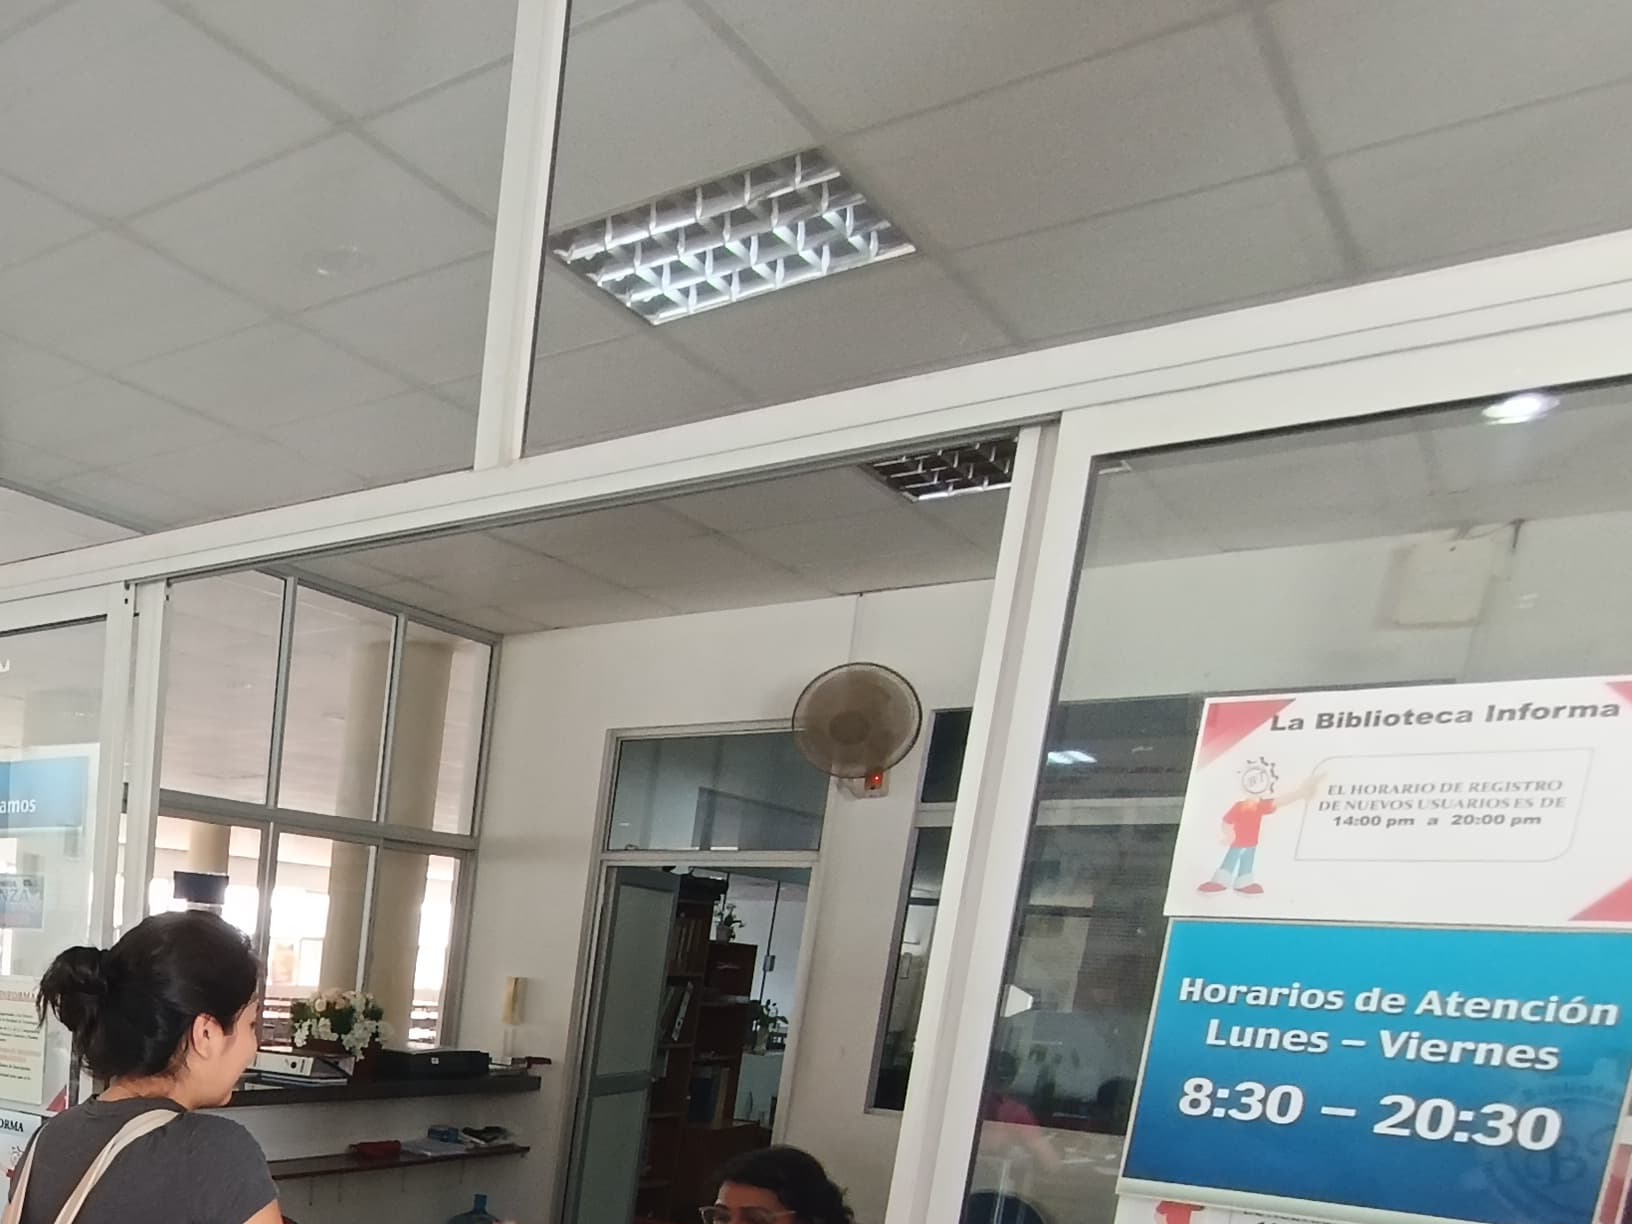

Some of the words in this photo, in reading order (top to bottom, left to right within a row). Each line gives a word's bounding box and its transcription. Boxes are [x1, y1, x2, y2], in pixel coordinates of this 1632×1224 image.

[1270, 713, 1304, 732] La
[1314, 705, 1474, 730] Biblioteca
[1484, 700, 1621, 723] Informa
[1318, 800, 1340, 812] DE
[1344, 799, 1414, 812] NUEVOS
[1417, 798, 1511, 810] USUARIOS
[1513, 797, 1534, 809] ES
[1539, 796, 1568, 809] DE
[1327, 784, 1347, 796] EL
[1350, 782, 1436, 796] HORARIO
[1439, 782, 1465, 794] DE
[1468, 780, 1563, 793] REGISTRO
[1333, 815, 1382, 827] 14:00
[1386, 817, 1416, 829] pm
[1426, 817, 1439, 826] a
[1451, 814, 1506, 826] 20:00
[1510, 816, 1542, 828] pm
[1178, 977, 1344, 1011] Horarios
[1354, 987, 1406, 1015] de
[1416, 990, 1620, 1027] Atención
[1205, 1019, 1330, 1053] Lunes
[1379, 1030, 1560, 1071] Viernes
[1178, 1077, 1304, 1126] 8:30
[1373, 1094, 1563, 1152] 20:30
